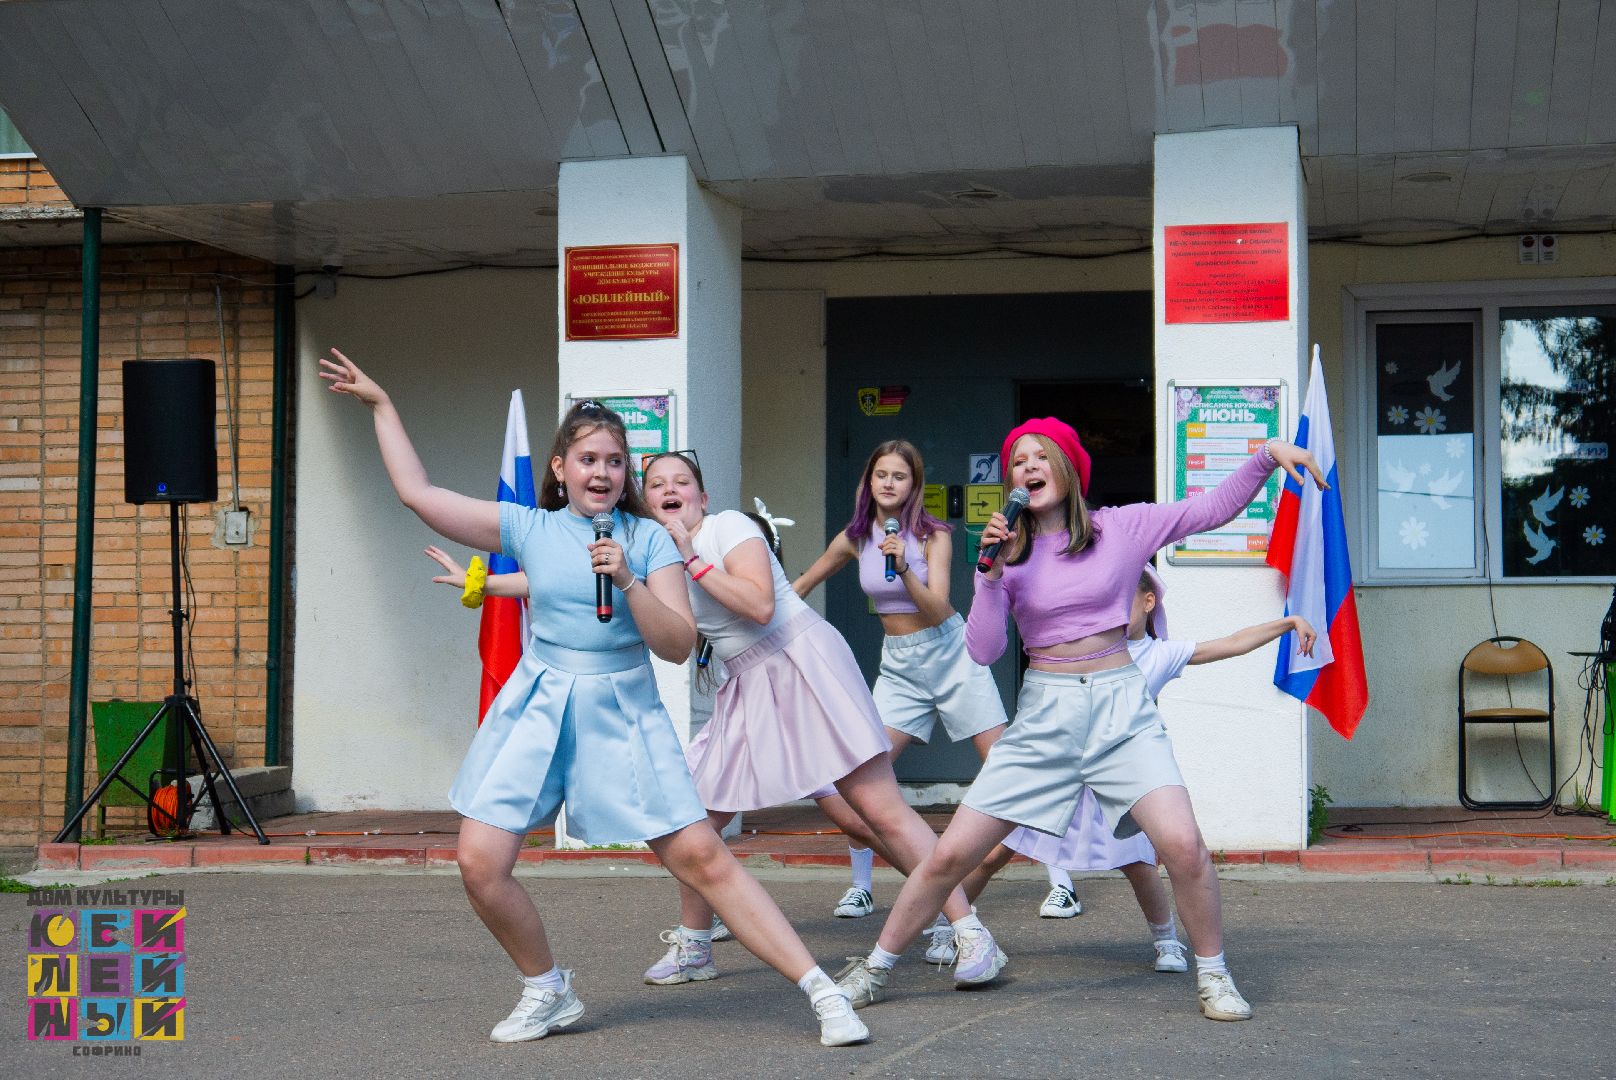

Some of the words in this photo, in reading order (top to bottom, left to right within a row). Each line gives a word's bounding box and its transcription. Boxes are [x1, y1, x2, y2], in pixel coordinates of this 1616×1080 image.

[630, 261, 670, 270] БЮДЖЕТНОЕ
[627, 269, 659, 277] КУЛЬТУРЫ
[612, 277, 645, 285] КУЛЬТУРЫ
[573, 290, 670, 304] «ЮБИЛЕЙНЫЙ»
[1199, 408, 1256, 422] ИЮНЬ
